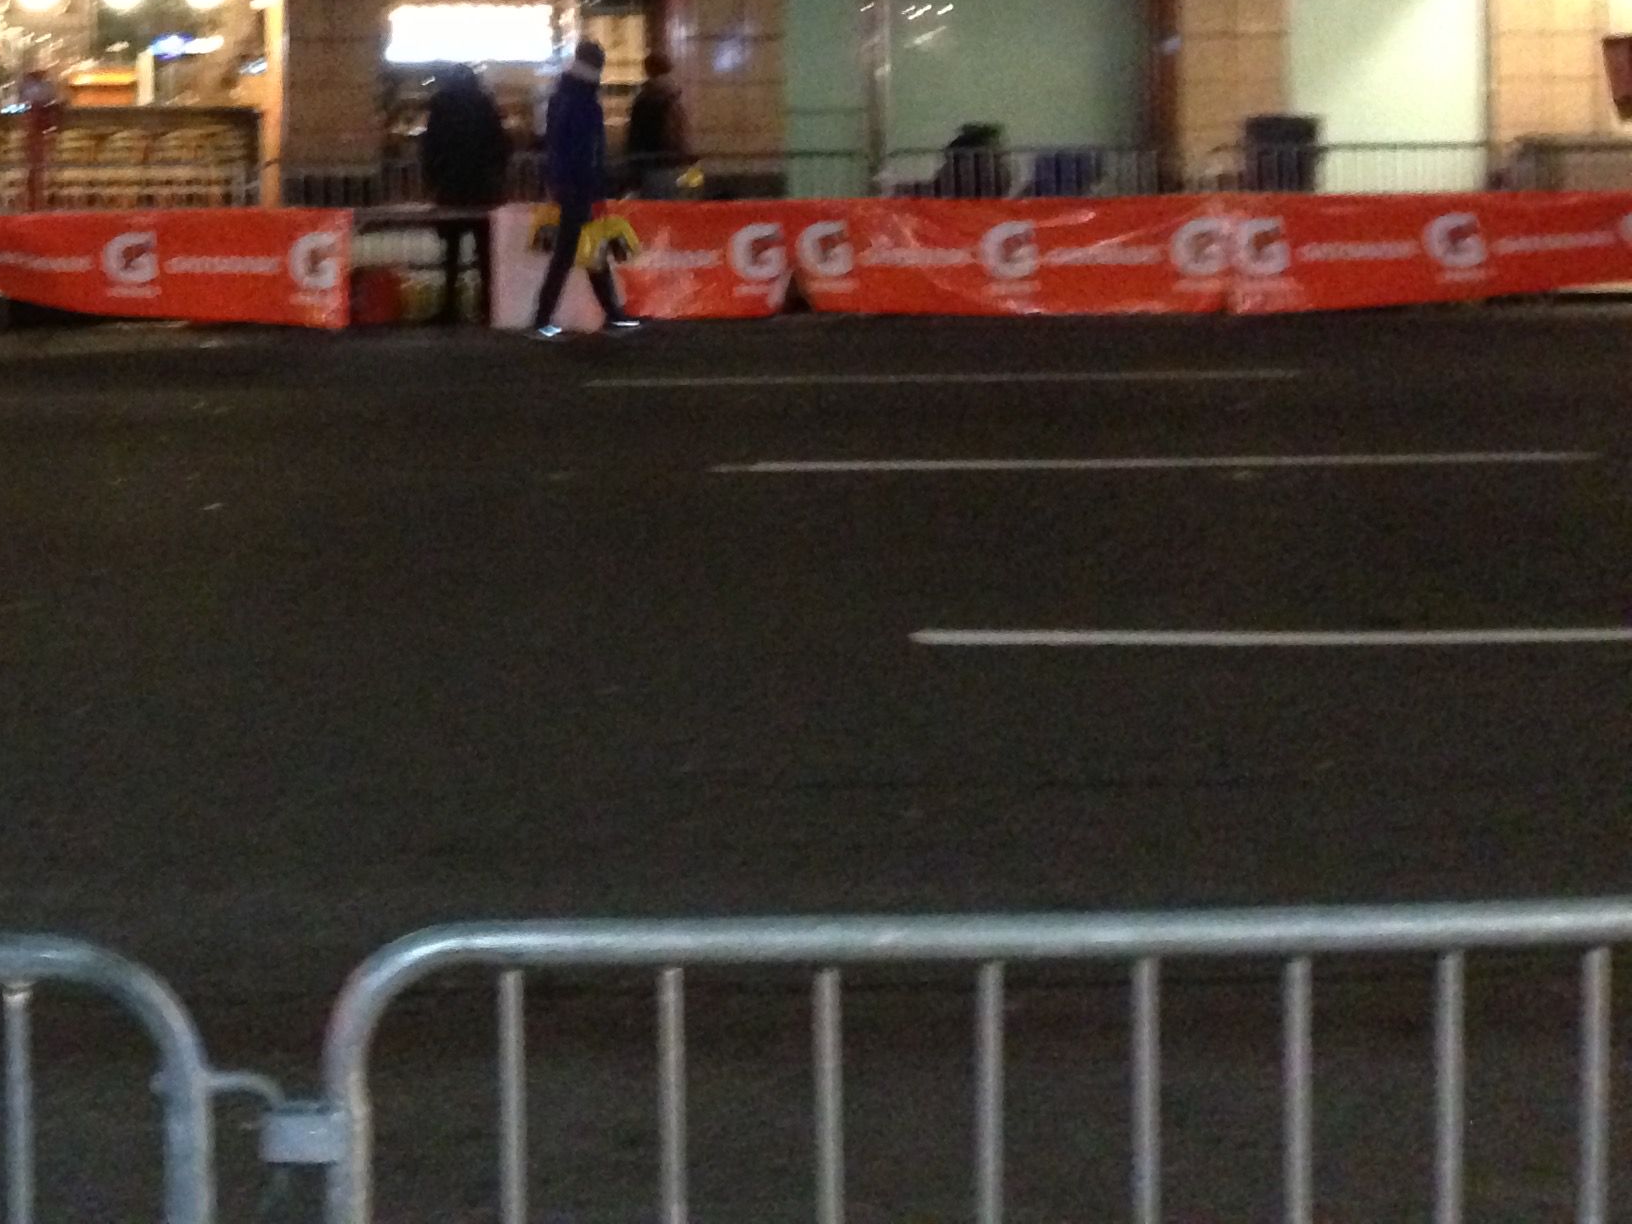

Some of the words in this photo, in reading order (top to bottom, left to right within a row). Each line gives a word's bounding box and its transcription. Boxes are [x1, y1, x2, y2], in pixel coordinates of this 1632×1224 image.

[103, 232, 158, 283] G
[289, 231, 340, 288] G
[728, 222, 787, 279] G
[796, 220, 854, 277] G
[979, 220, 1039, 278] G
[1234, 216, 1291, 276] G
[1424, 211, 1486, 268] G
